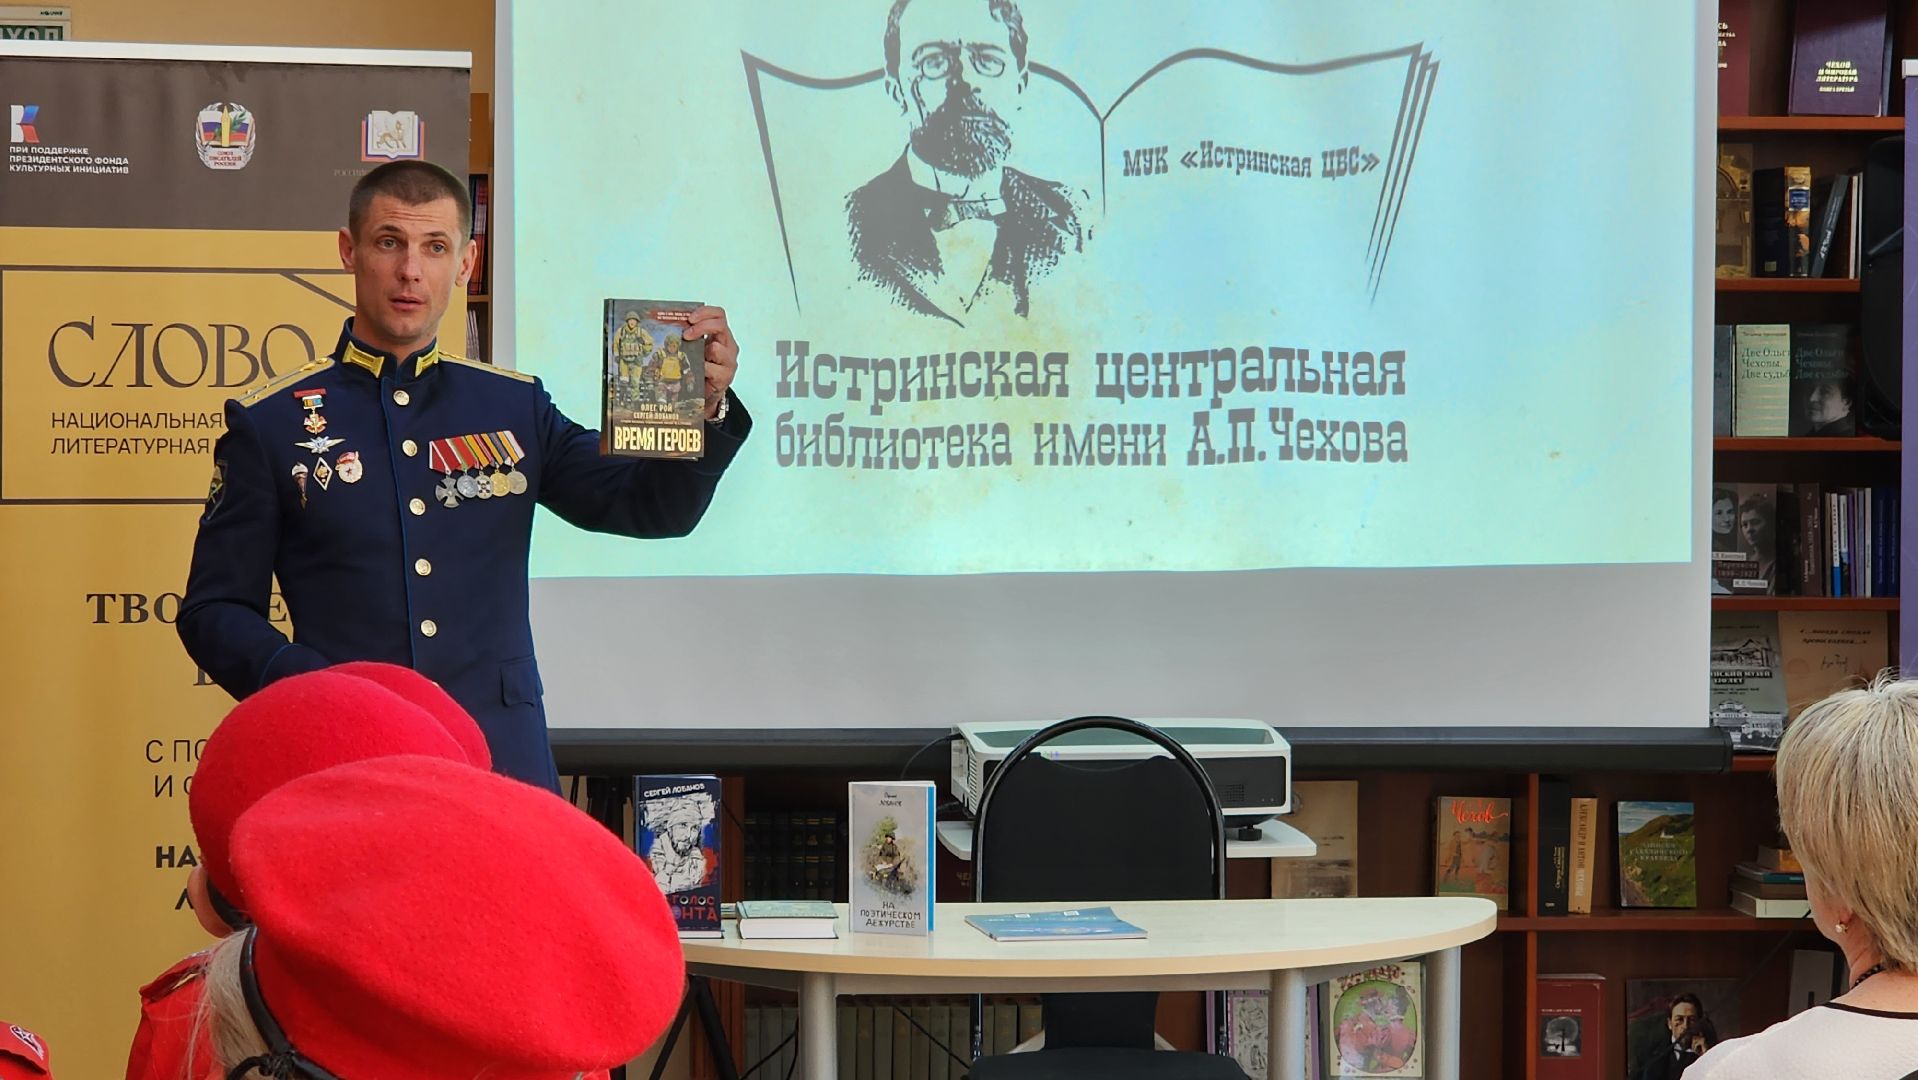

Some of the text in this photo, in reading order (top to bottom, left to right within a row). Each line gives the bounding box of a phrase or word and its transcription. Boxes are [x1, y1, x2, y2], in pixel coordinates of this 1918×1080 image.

[9, 146, 89, 155] ПРИ ПОДДЕРЖКЕ
[9, 155, 129, 165] ПРЕЗИДЕНТСКОГО ФОНДА
[1123, 140, 1380, 181] МУК «Истринская ЦБС»
[9, 165, 129, 174] КУЛЬТУРНЫХ ИНИЦИАТИВ
[776, 340, 1406, 416] Истринская центральная
[660, 403, 673, 412] РОЙ
[52, 412, 222, 430] НАЦИОНАЛЬНАЯ
[51, 438, 209, 454] ЛИТЕРАТУРНАЯ
[614, 426, 702, 452] ВРЕМЯ ГЕРОЕВ
[776, 410, 1013, 470] библиотека
[1034, 422, 1167, 467] имени
[146, 740, 163, 763] С
[155, 775, 172, 797] И
[643, 783, 705, 798] СЕРГЕЙ ЛОБАНОВ
[883, 901, 895, 909] НА
[671, 906, 718, 921] ОНТА
[860, 909, 921, 920] ПОЭТИЧЕСКОМ
[866, 918, 915, 928] ДЕЖУРСТВЕ
